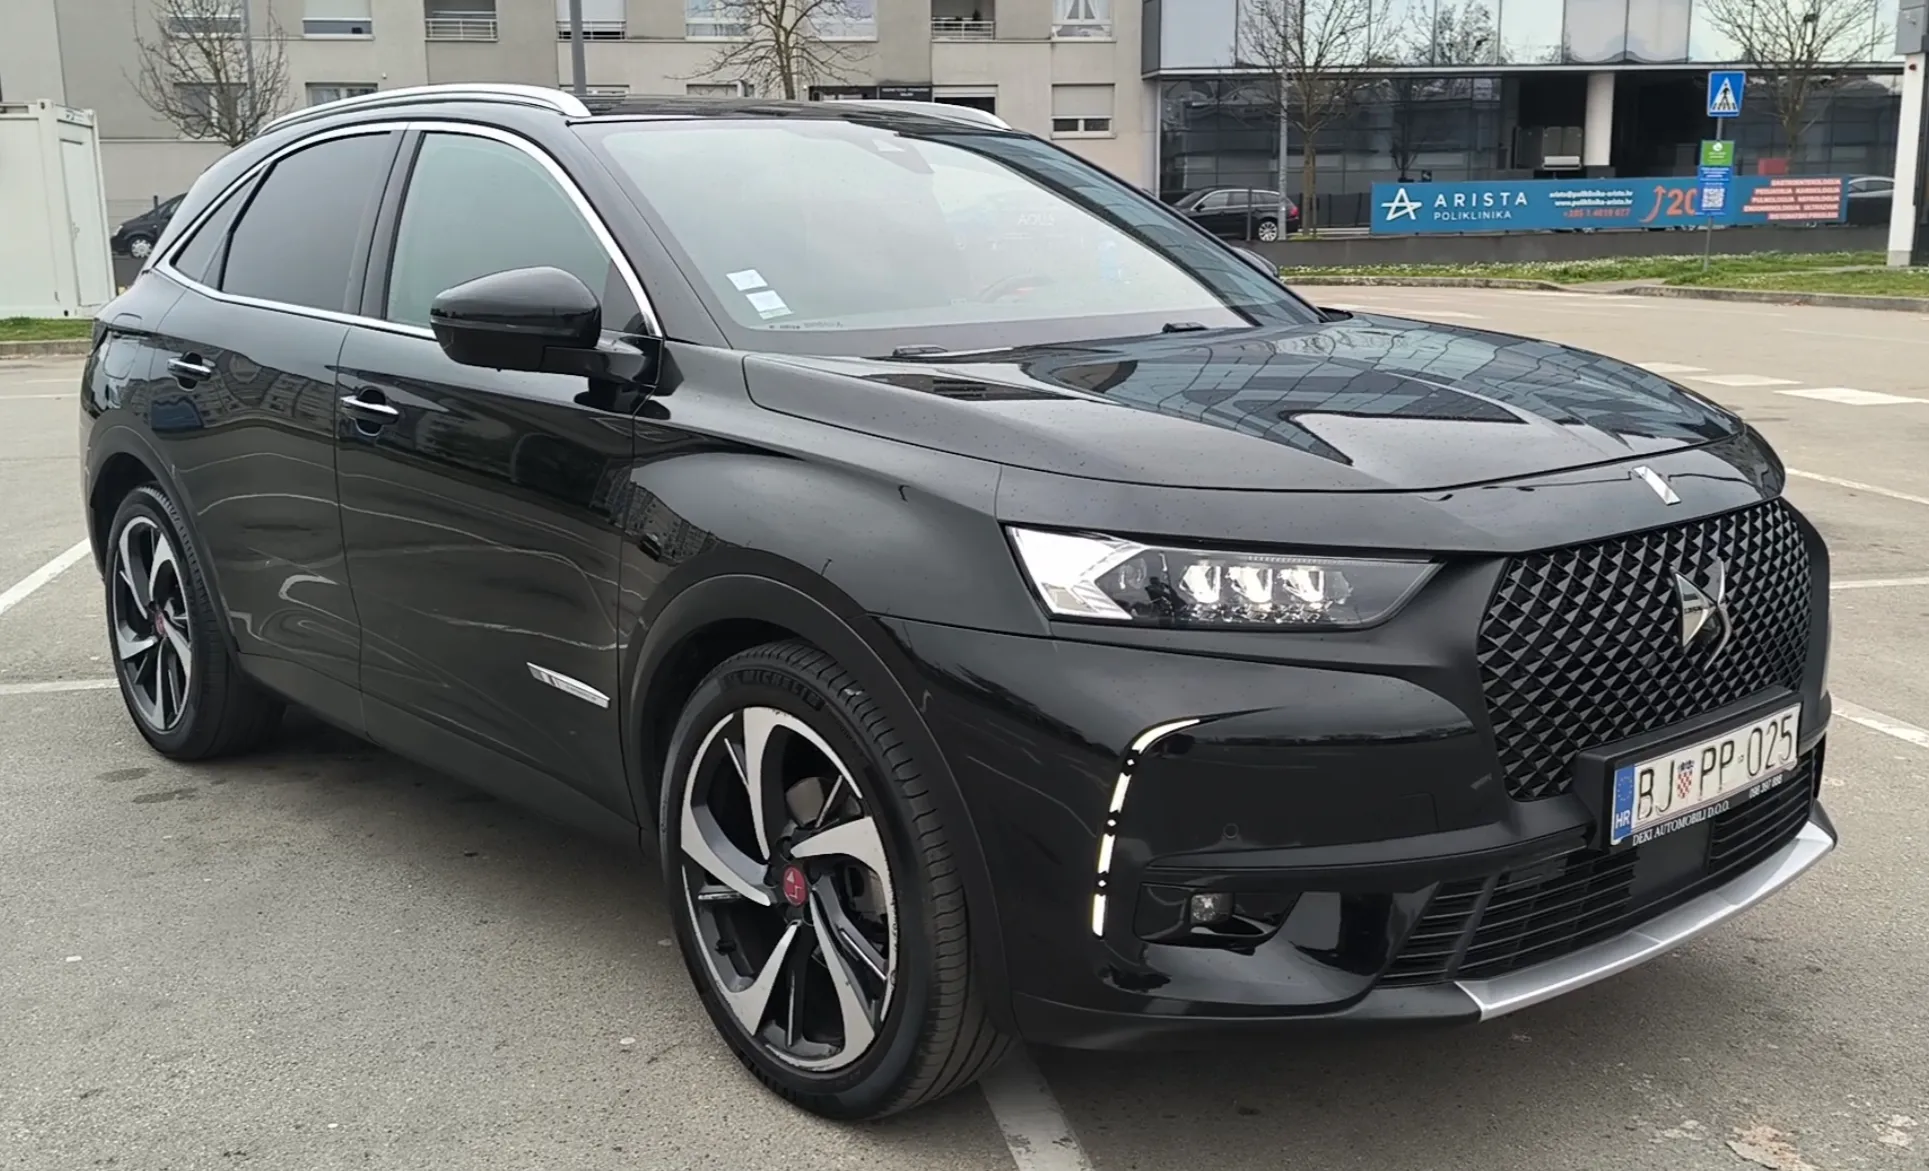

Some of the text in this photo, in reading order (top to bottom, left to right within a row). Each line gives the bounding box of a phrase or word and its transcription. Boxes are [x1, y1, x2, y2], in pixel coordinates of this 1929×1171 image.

[1433, 191, 1528, 208] ARISTA
[1433, 210, 1512, 221] POLIKLINIKA
[1637, 759, 1676, 821] BJ
[1615, 809, 1631, 830] HR
[1632, 828, 1654, 847] DEKI
[1654, 809, 1707, 839] AUTOMOBILI
